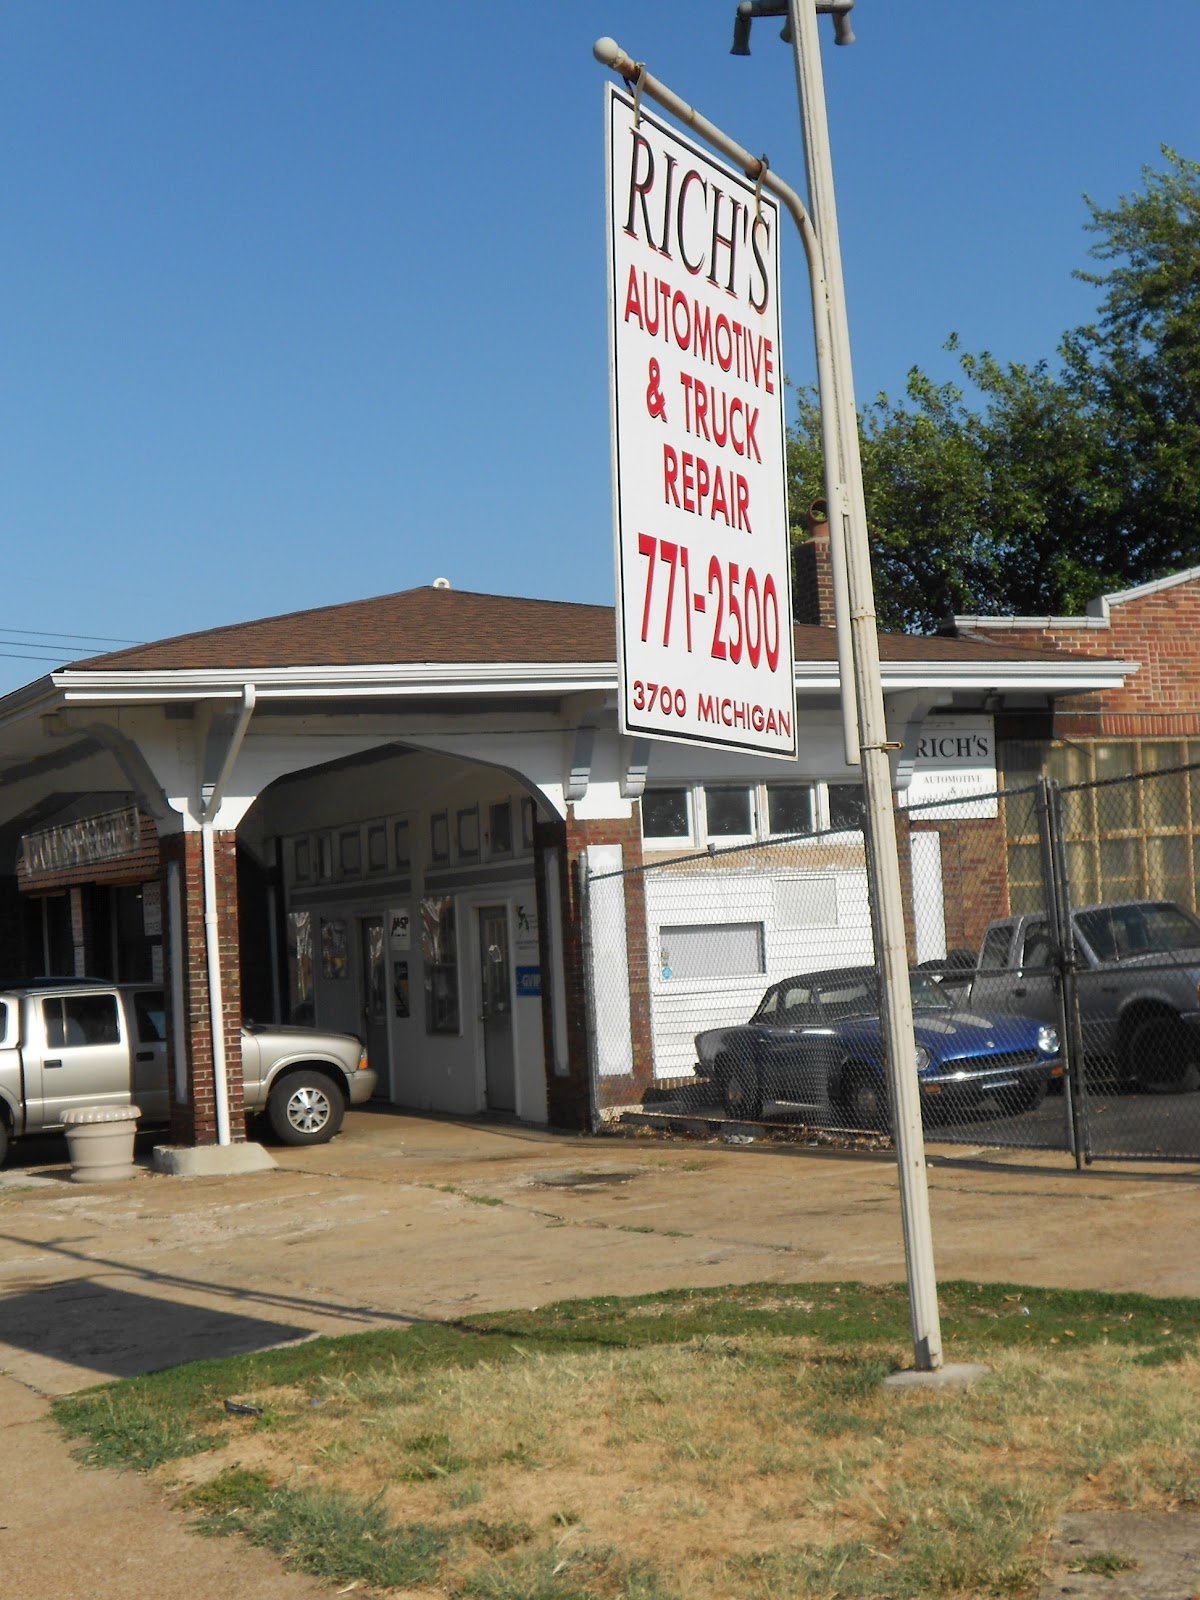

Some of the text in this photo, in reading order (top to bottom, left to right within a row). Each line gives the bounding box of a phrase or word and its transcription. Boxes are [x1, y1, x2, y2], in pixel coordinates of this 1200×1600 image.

[622, 127, 770, 315] RICH'S
[624, 264, 774, 395] AUTOMOTIVE
[646, 356, 762, 464] & TRUCK
[663, 443, 752, 534] REPAIR
[638, 532, 779, 673] 771-2500
[633, 680, 791, 737] 3700 MICHIGAN
[916, 735, 988, 758] RICH'S
[923, 775, 983, 785] AUTOMOTIVE
